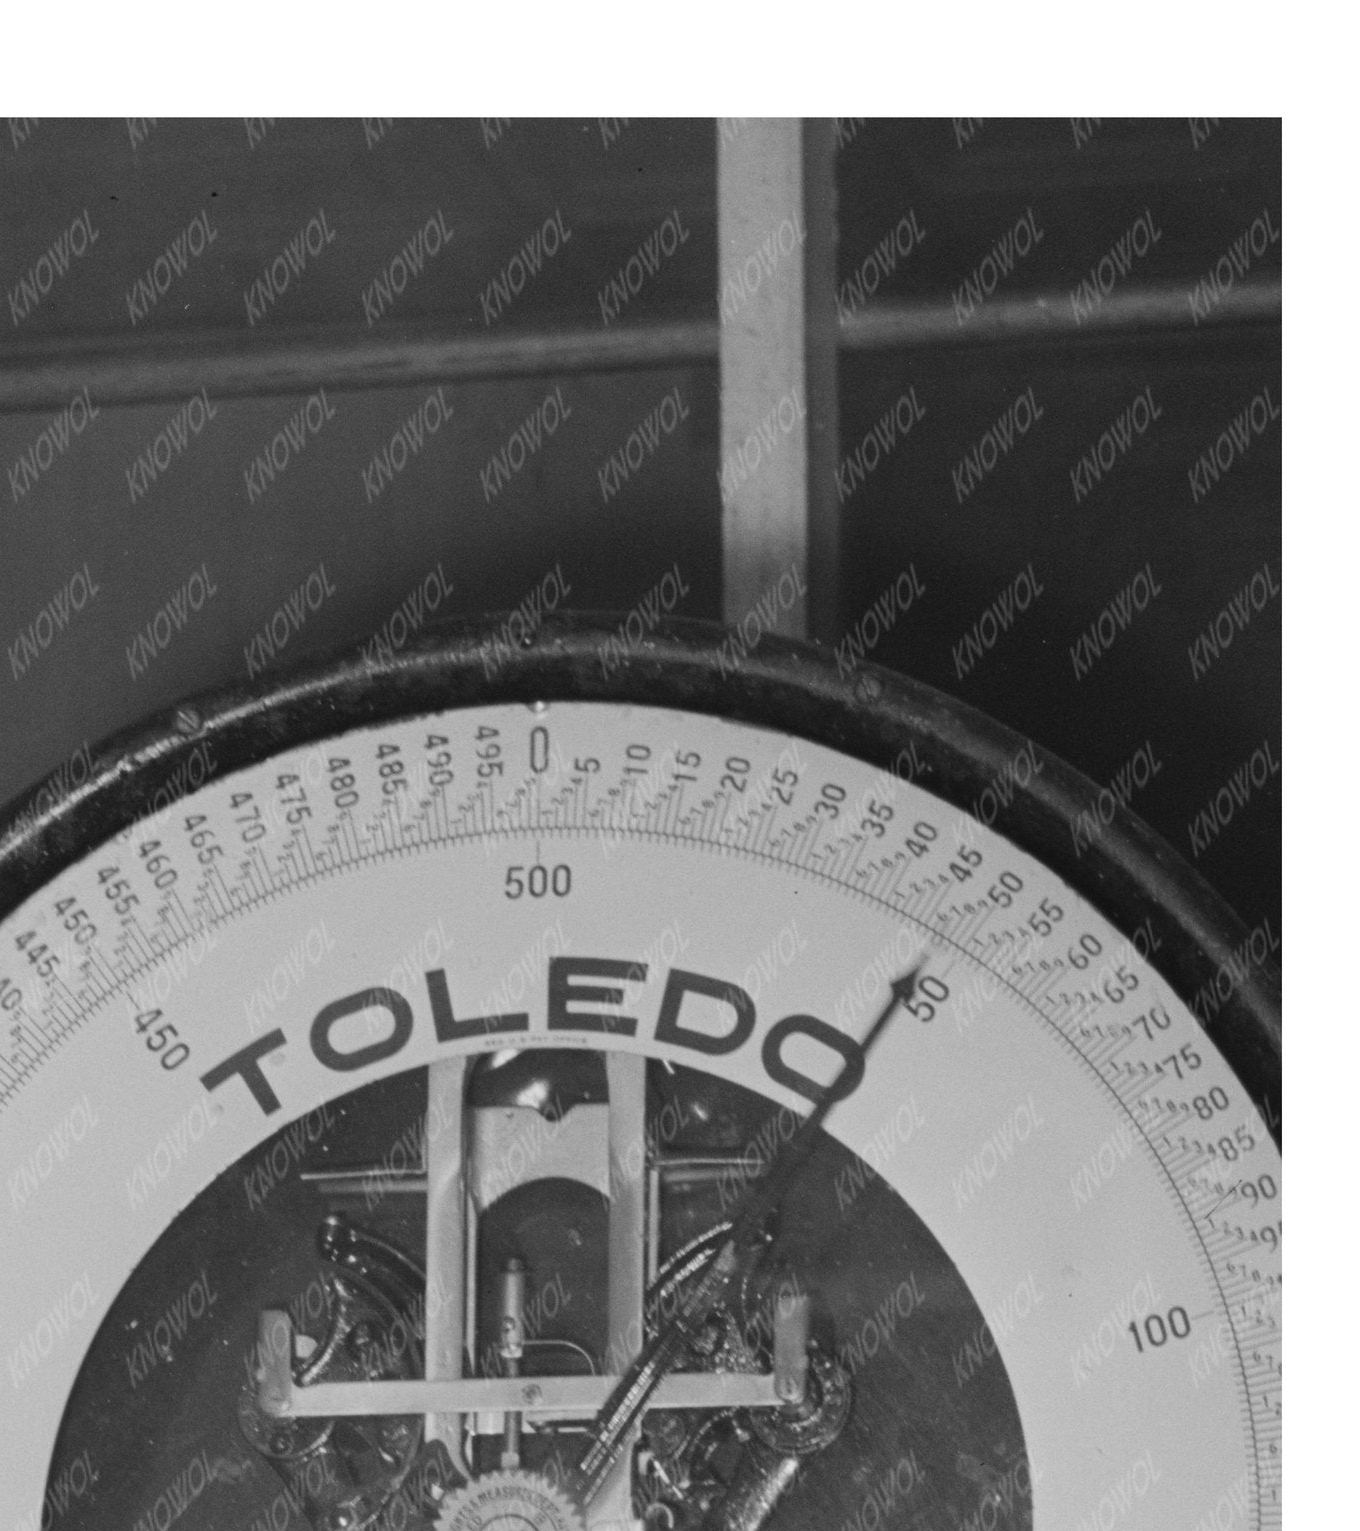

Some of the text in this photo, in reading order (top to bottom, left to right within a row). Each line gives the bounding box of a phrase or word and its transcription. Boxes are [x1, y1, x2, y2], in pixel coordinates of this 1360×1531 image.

[378, 742, 408, 794] 485
[425, 733, 454, 786] 490
[475, 725, 504, 778] 495
[530, 726, 549, 773] 0
[574, 758, 600, 774] 5
[623, 744, 651, 776] 10
[674, 750, 702, 783] 15
[328, 755, 359, 808] 480
[721, 756, 751, 793] 20
[772, 769, 799, 806] 25
[230, 791, 267, 843] 470
[276, 772, 312, 823] 475
[814, 783, 847, 819] 30
[861, 800, 896, 838] 35
[183, 813, 224, 866] 465
[905, 821, 939, 859] 40
[138, 838, 178, 890] 460
[504, 864, 571, 899] 500
[949, 844, 985, 884] 45
[97, 865, 140, 916] 455
[988, 870, 1024, 909] 50
[54, 896, 98, 945] 450
[1030, 898, 1065, 937] 55
[14, 930, 61, 979] 445
[1067, 933, 1103, 971] 60
[903, 974, 951, 1024] 50
[1103, 964, 1140, 1004] 65
[133, 1008, 191, 1071] 450
[199, 956, 865, 1118] TOLEDO
[1133, 1007, 1171, 1041] 70
[1163, 1042, 1203, 1080] 75
[1192, 1086, 1230, 1121] 80
[1217, 1124, 1256, 1162] 85
[1240, 1174, 1277, 1209] 90
[1129, 1305, 1191, 1353] 100
